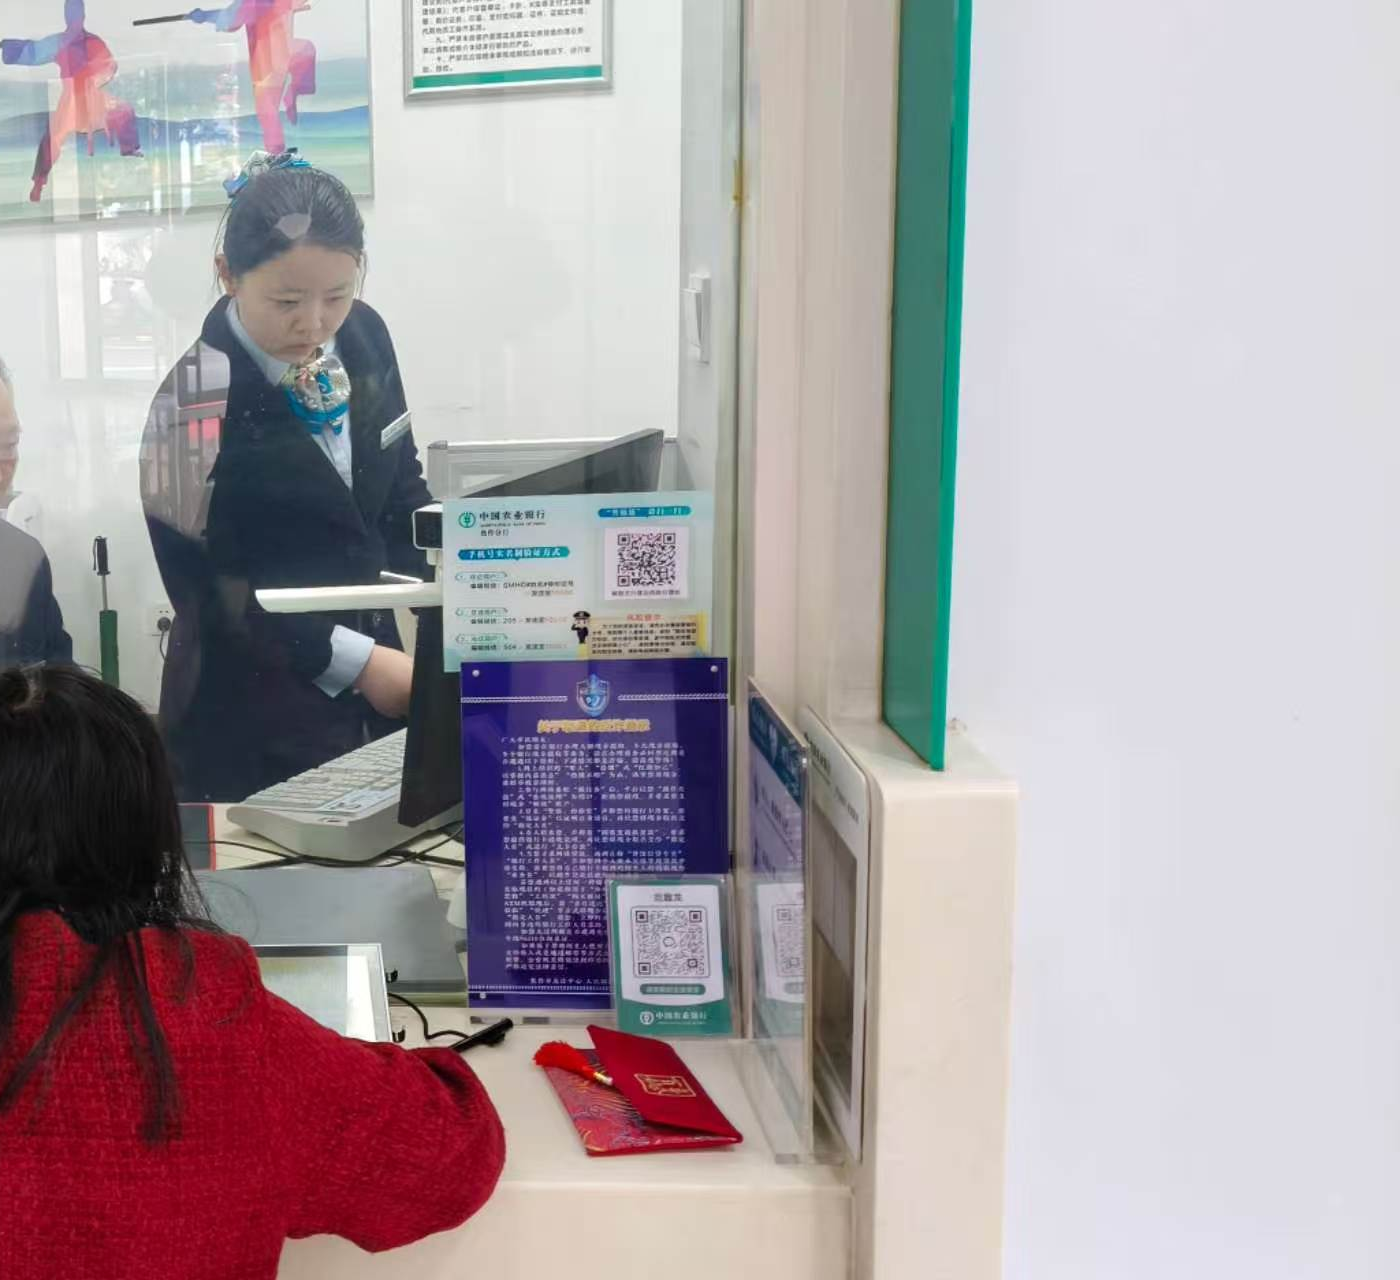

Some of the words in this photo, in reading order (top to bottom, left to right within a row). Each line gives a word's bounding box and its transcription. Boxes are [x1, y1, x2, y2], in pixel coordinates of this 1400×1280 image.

[479, 510, 545, 521] 中国农业银行
